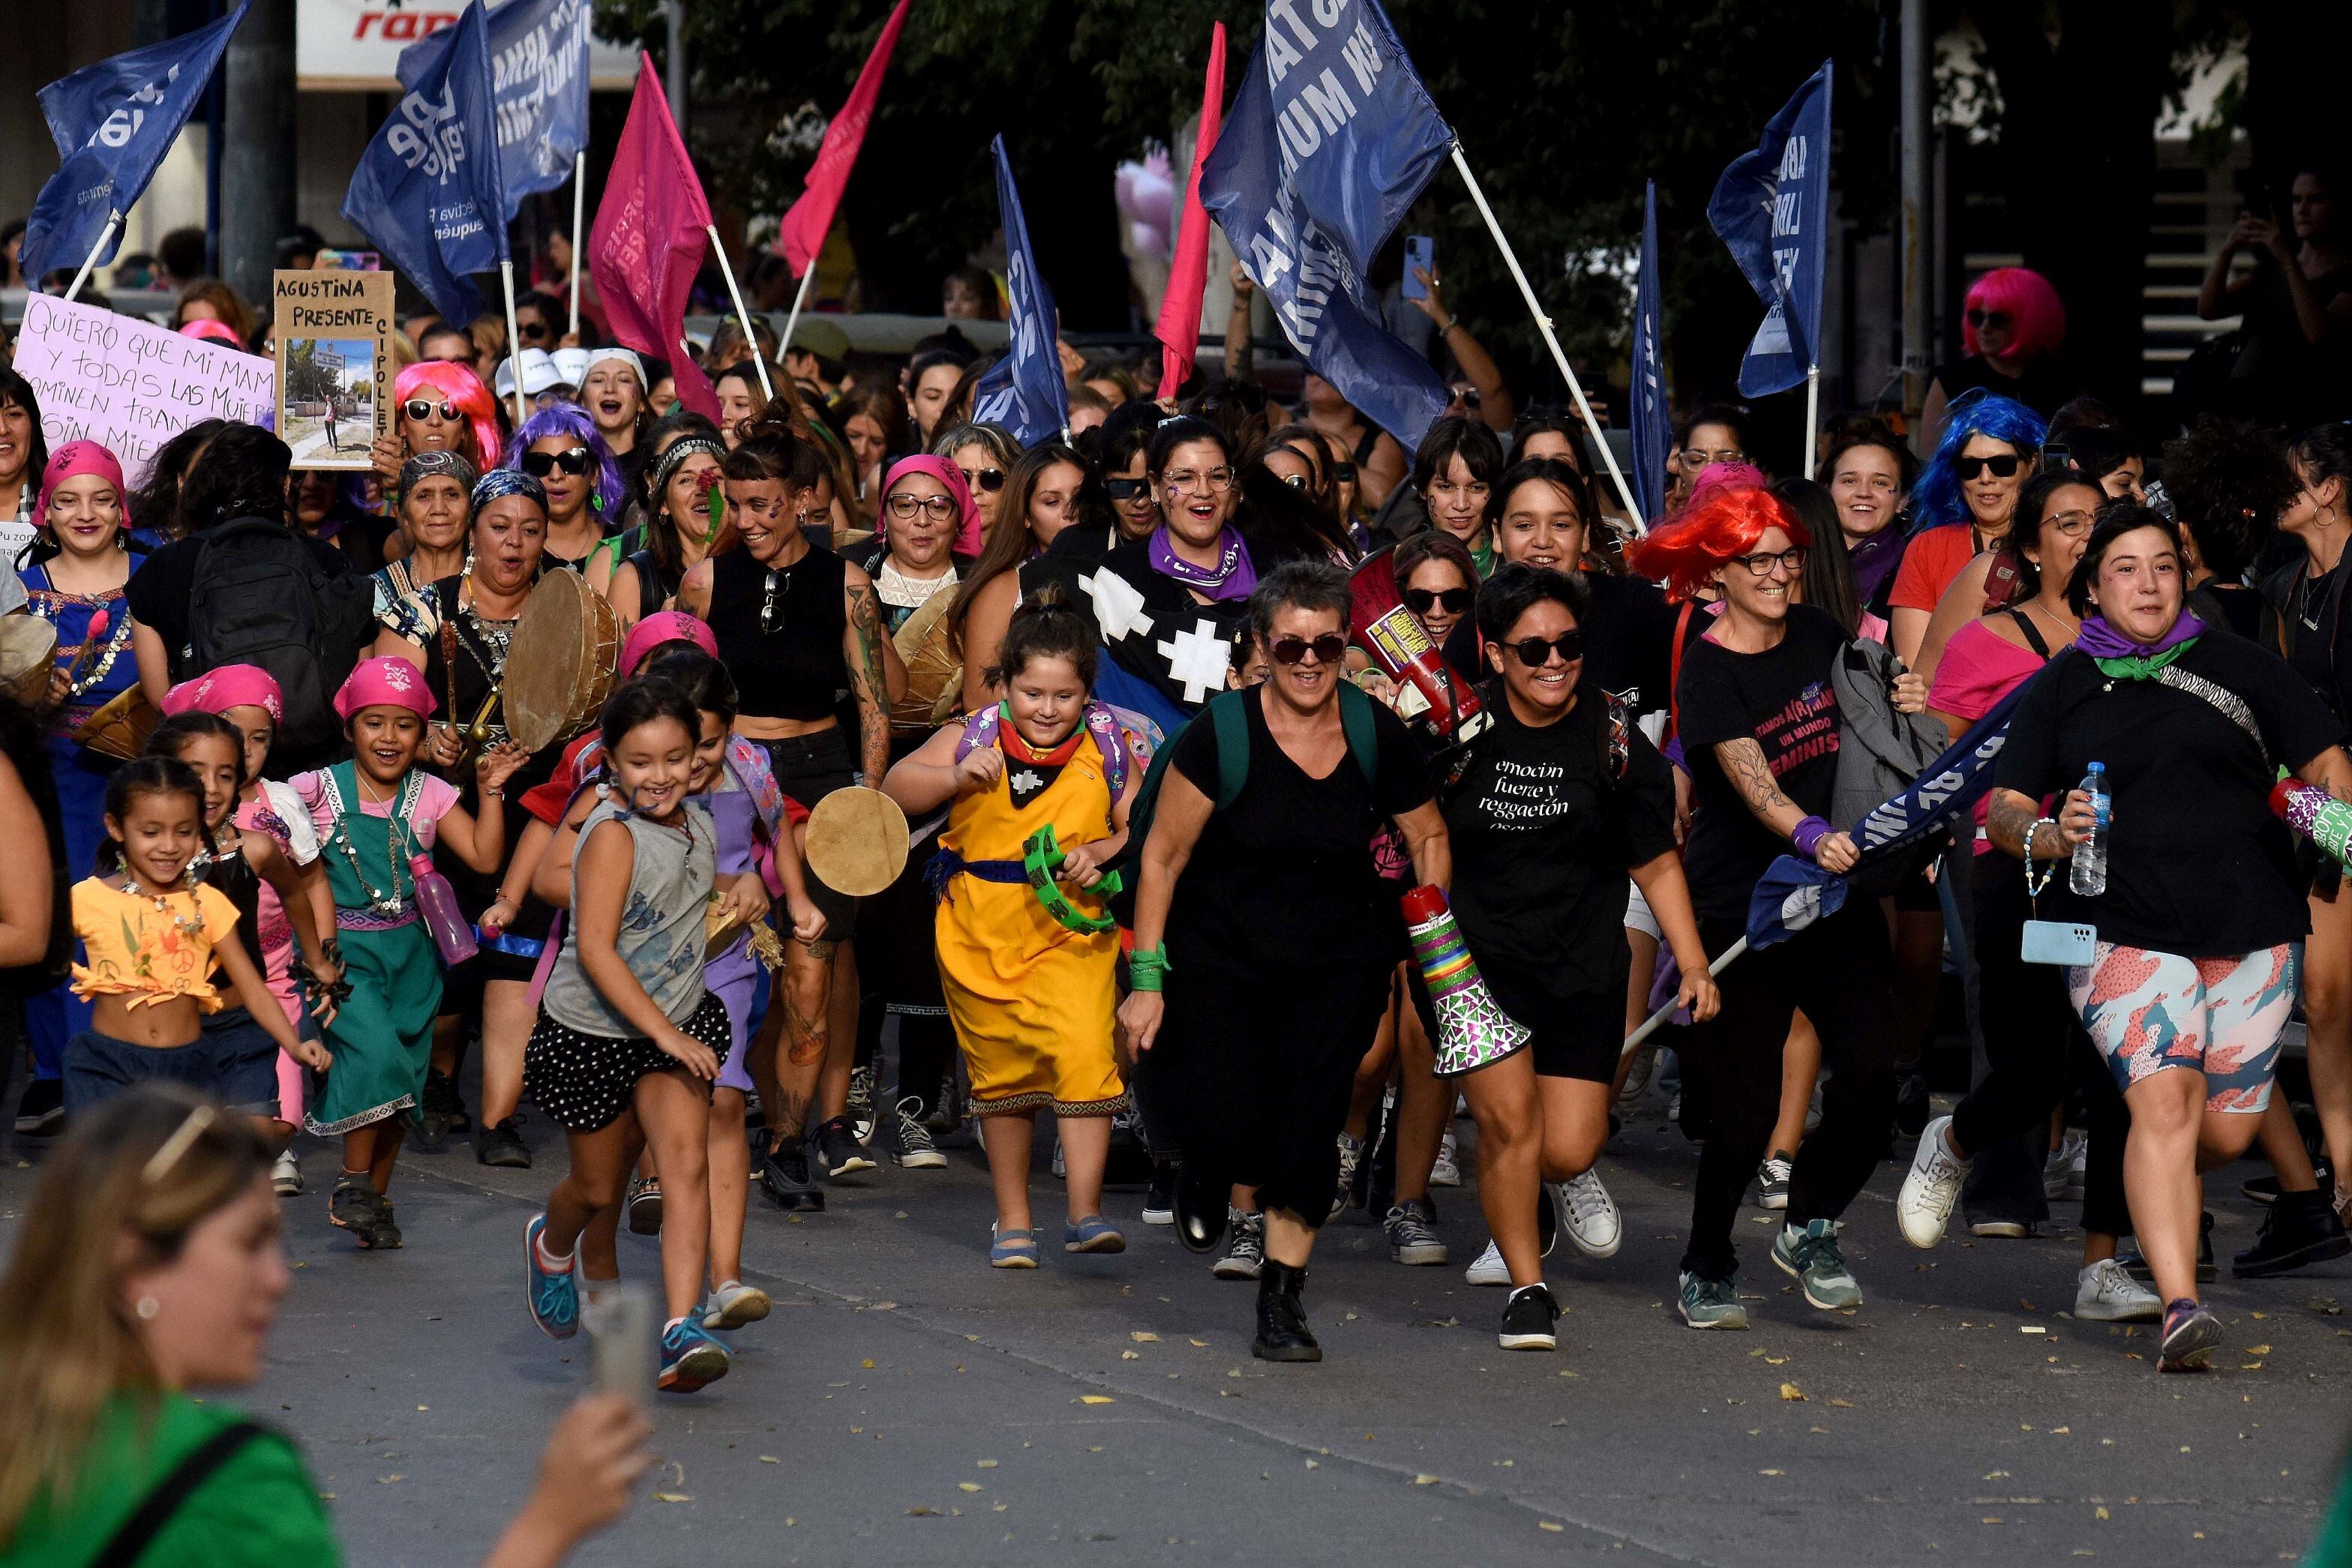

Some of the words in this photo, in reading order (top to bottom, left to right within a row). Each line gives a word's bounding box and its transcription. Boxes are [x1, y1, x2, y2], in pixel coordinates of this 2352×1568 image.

[293, 306, 374, 328] PRESENTE
[128, 334, 173, 364] QUE
[220, 360, 275, 399] MAM
[376, 319, 387, 436] CIPOLLET
[171, 378, 205, 406] LAS
[1388, 614, 1426, 655] ABORTAR?
[1779, 733, 1795, 747] UN
[1793, 717, 1832, 739] MUNDO
[1496, 760, 1564, 778] emoción
[1768, 732, 1840, 778] EMINIS
[1494, 776, 1543, 799] fuerte
[1545, 785, 1558, 802] y
[1478, 797, 1569, 820] reggaetón
